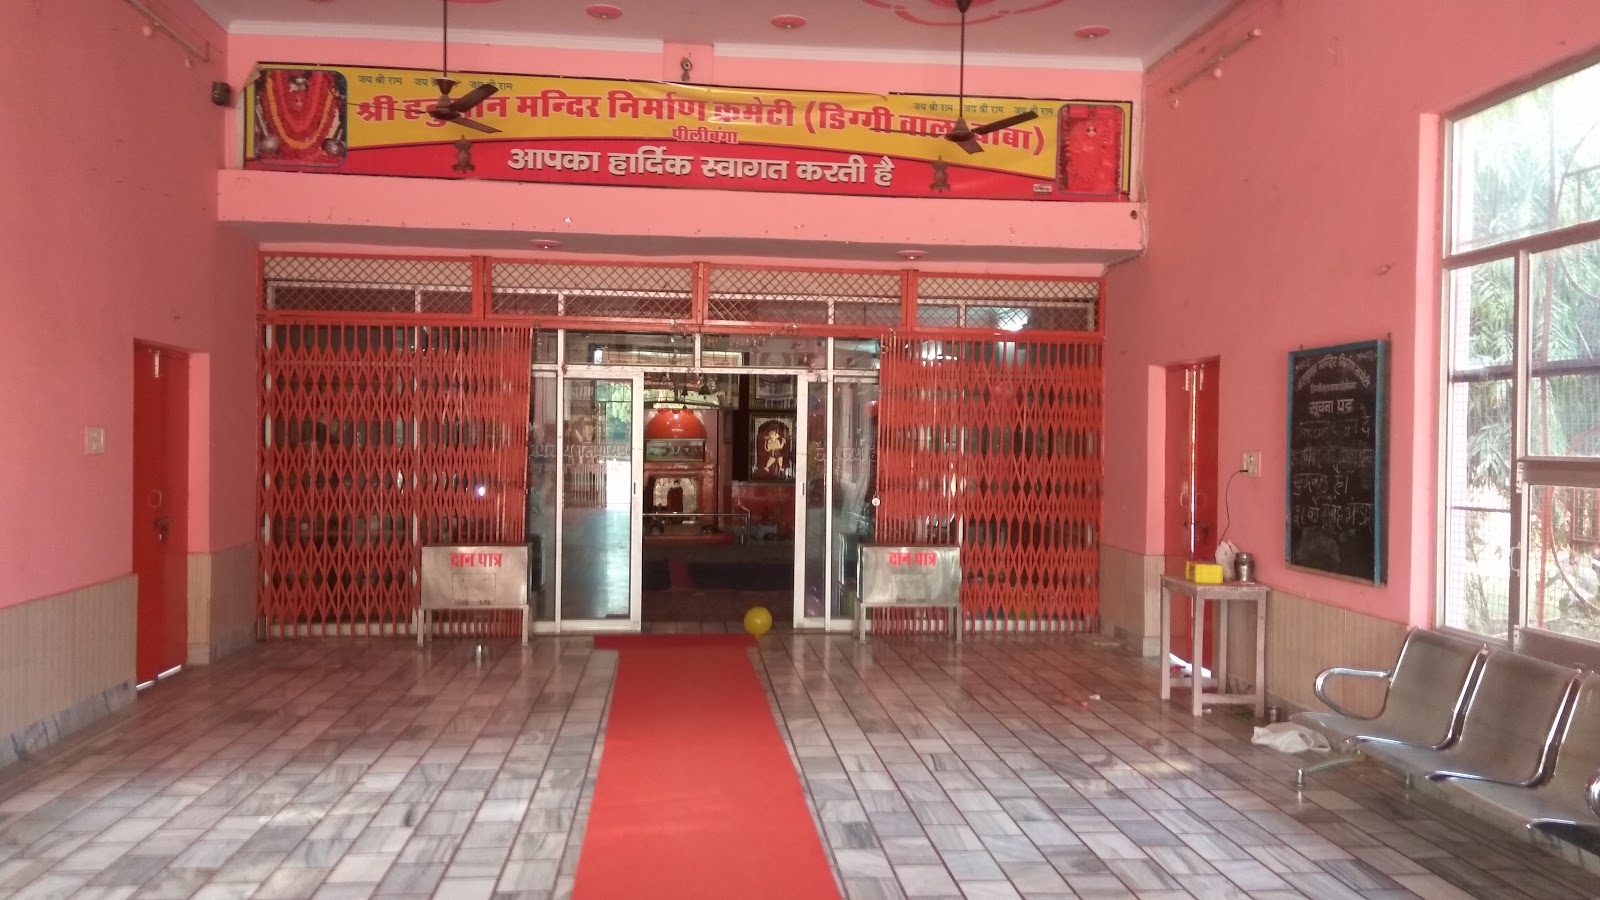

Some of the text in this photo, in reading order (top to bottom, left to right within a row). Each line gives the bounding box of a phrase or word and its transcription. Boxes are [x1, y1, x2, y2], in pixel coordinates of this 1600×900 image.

[358, 75, 372, 84] जय
[375, 73, 385, 84] श्री
[387, 77, 402, 85] राम
[413, 77, 428, 86] जय
[498, 82, 513, 91] राम
[356, 94, 398, 122] श्री
[402, 96, 510, 128] हनुान
[516, 88, 602, 119] मन्दिर
[606, 90, 708, 122] निर्माण
[913, 102, 926, 111] जय
[928, 101, 938, 111] श्री
[940, 103, 953, 112] राम
[963, 104, 977, 112] जय
[979, 103, 988, 113] श्री
[990, 105, 1004, 114] राम
[1040, 106, 1054, 115] राम
[671, 125, 740, 145] पीलीबंगा
[507, 145, 896, 187] आपका हार्दिक स्वागत करती है
[1308, 399, 1334, 418] सूचना
[449, 552, 504, 568] दान पात्र
[888, 551, 938, 567] दान पात्र
